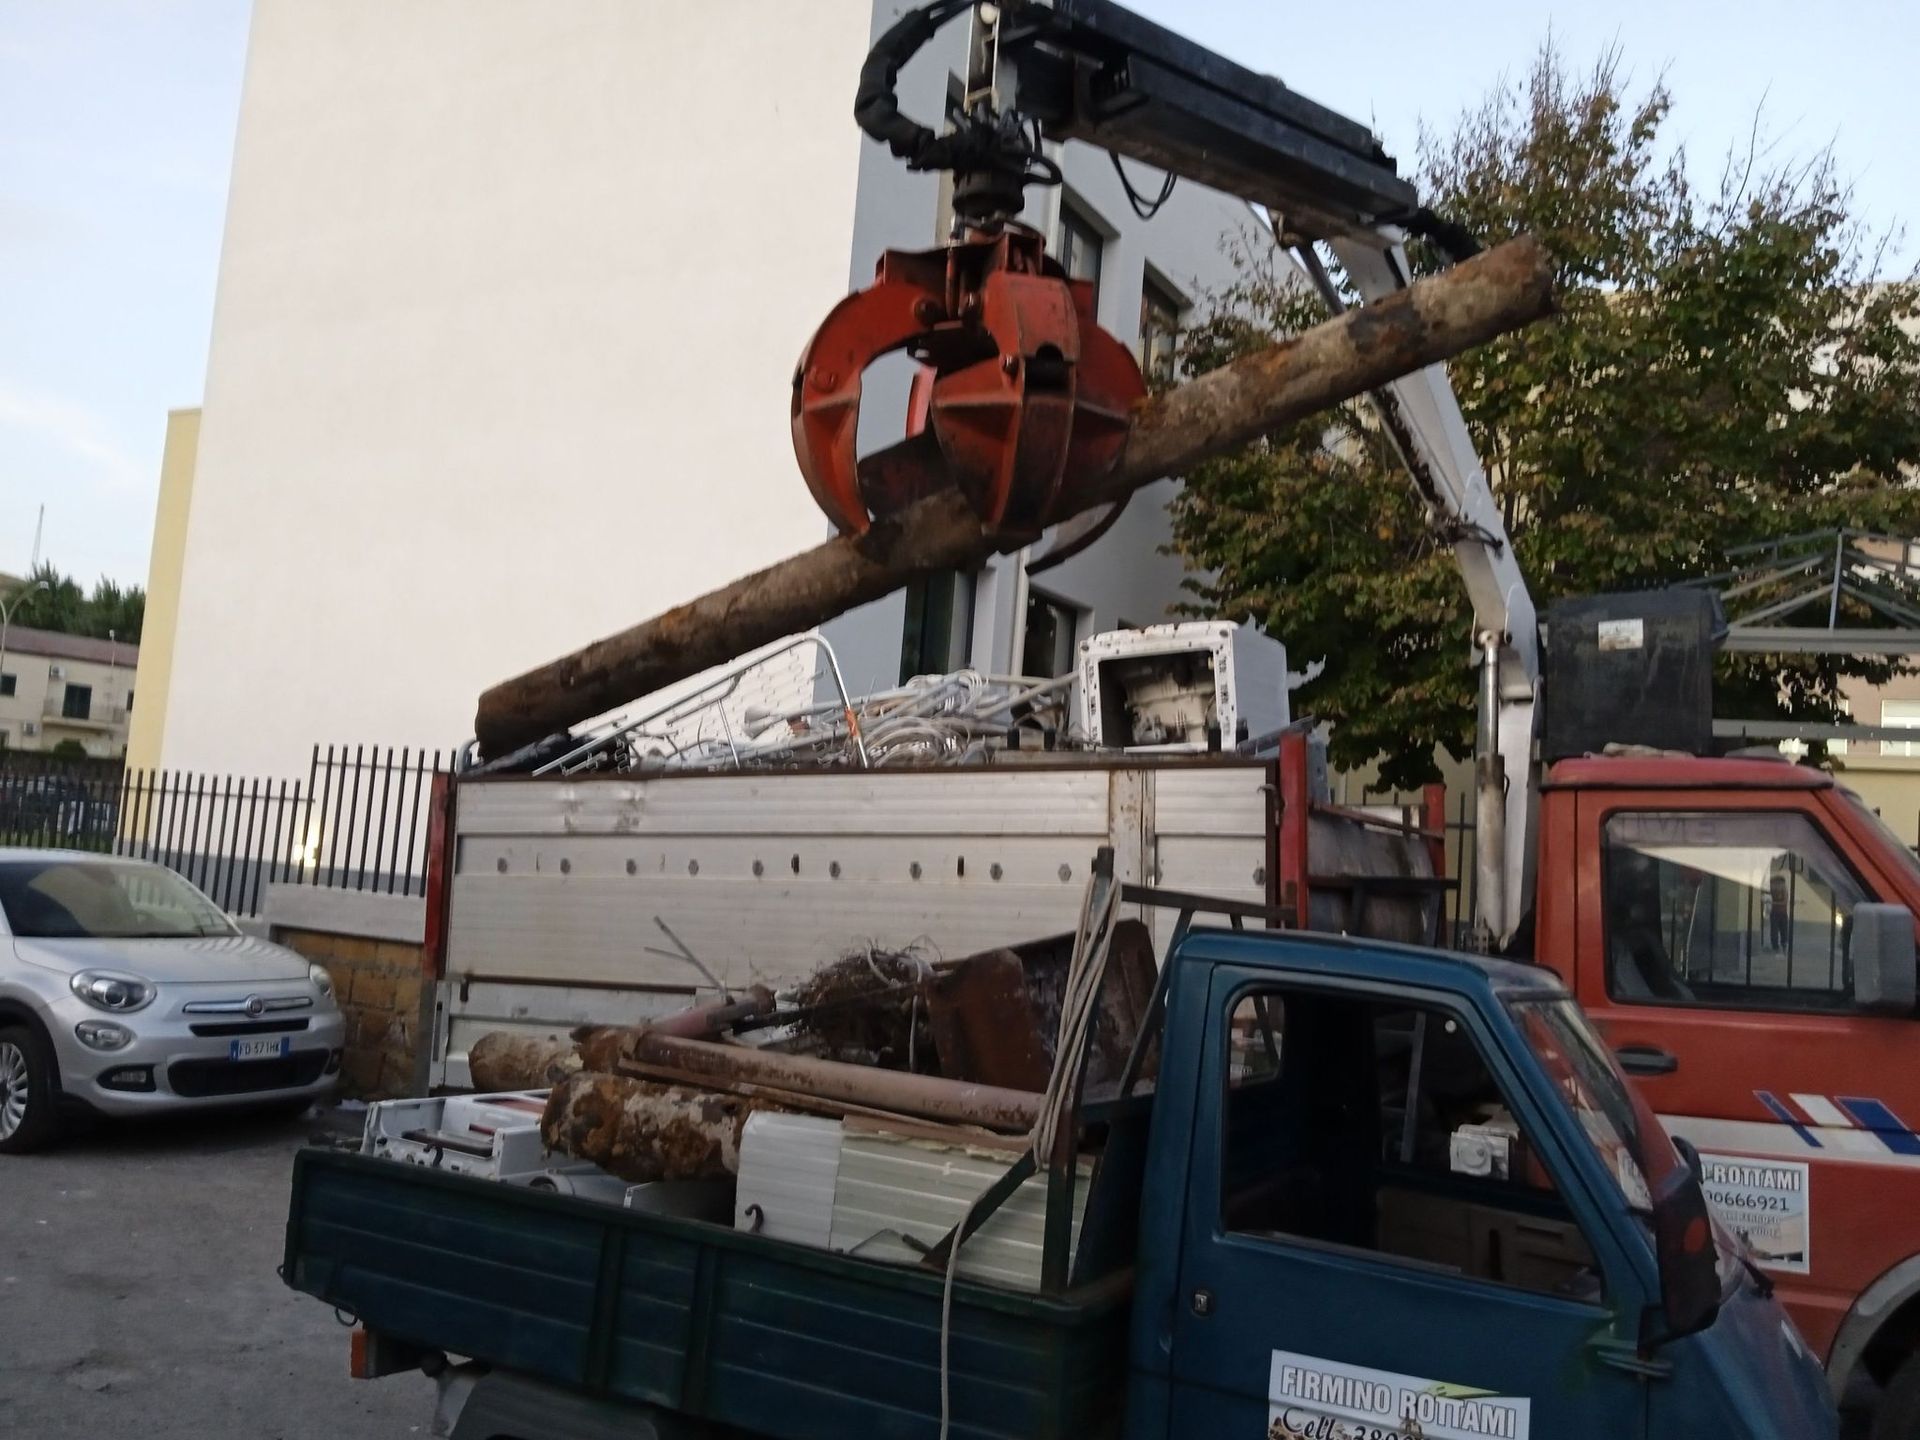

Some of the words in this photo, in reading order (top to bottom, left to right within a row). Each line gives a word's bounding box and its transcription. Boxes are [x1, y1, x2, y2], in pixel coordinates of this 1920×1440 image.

[1712, 1163, 1801, 1192] ROTTAMI
[1280, 1365, 1392, 1415] FIRMINO
[1399, 1388, 1517, 1439] ROTTAMI
